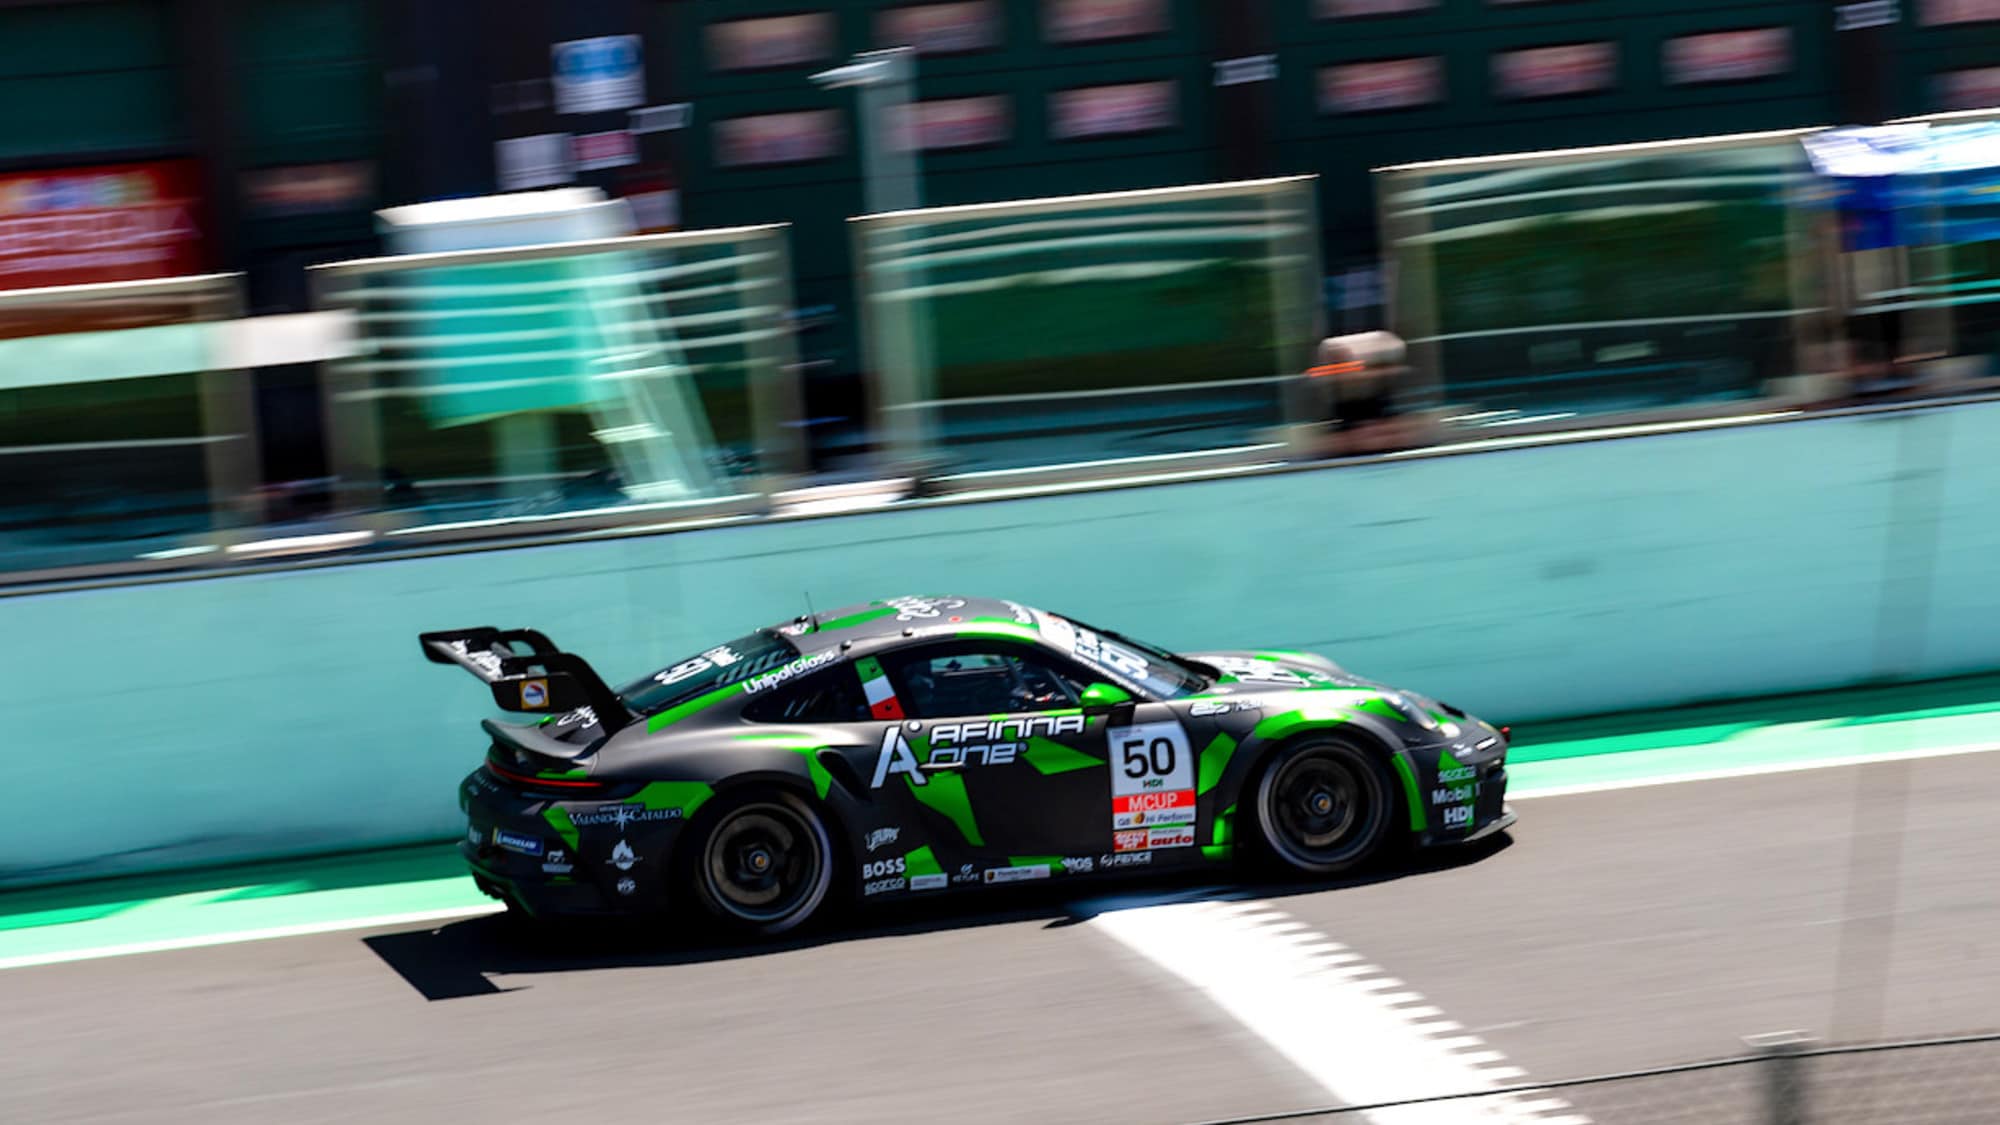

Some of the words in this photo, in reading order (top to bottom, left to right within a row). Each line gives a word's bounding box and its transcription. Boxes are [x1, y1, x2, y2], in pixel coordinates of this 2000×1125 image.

[1123, 737, 1176, 779] 50
[1128, 792, 1178, 812] MCUP
[1431, 784, 1473, 805] Mobil
[1443, 804, 1474, 825] HDI
[1150, 833, 1193, 847] auto
[863, 857, 906, 879] BOSS
